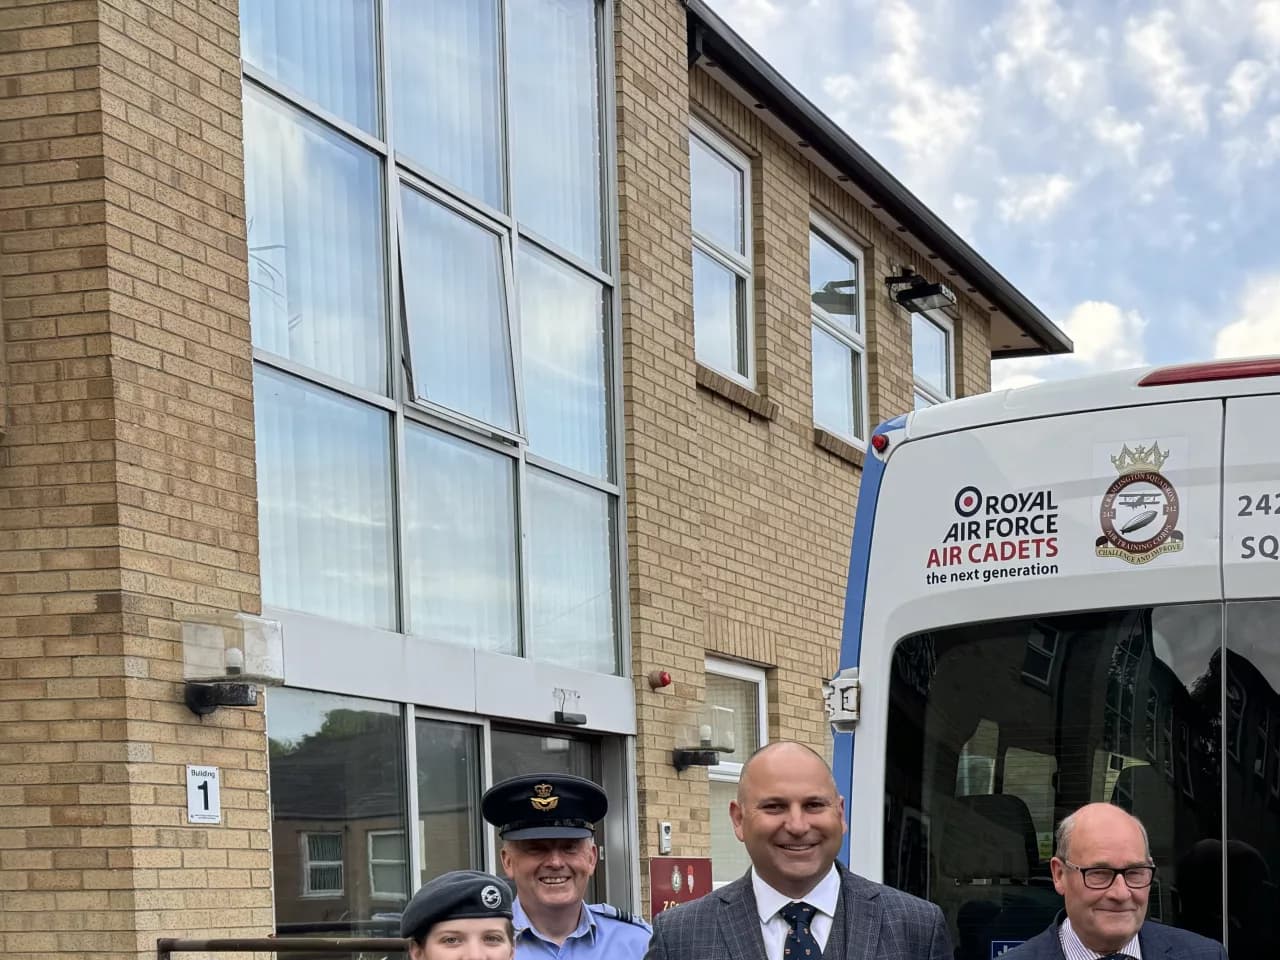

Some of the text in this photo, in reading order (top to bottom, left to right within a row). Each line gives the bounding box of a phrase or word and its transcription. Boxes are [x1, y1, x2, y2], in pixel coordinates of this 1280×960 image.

[985, 490, 1059, 515] ROYAL
[943, 513, 1059, 544] AIR FORCE
[926, 537, 1059, 569] AIR CADETS
[1136, 555, 1151, 563] AND
[926, 562, 1059, 585] the next generation
[191, 769, 216, 779] Building
[197, 780, 209, 811] 1
